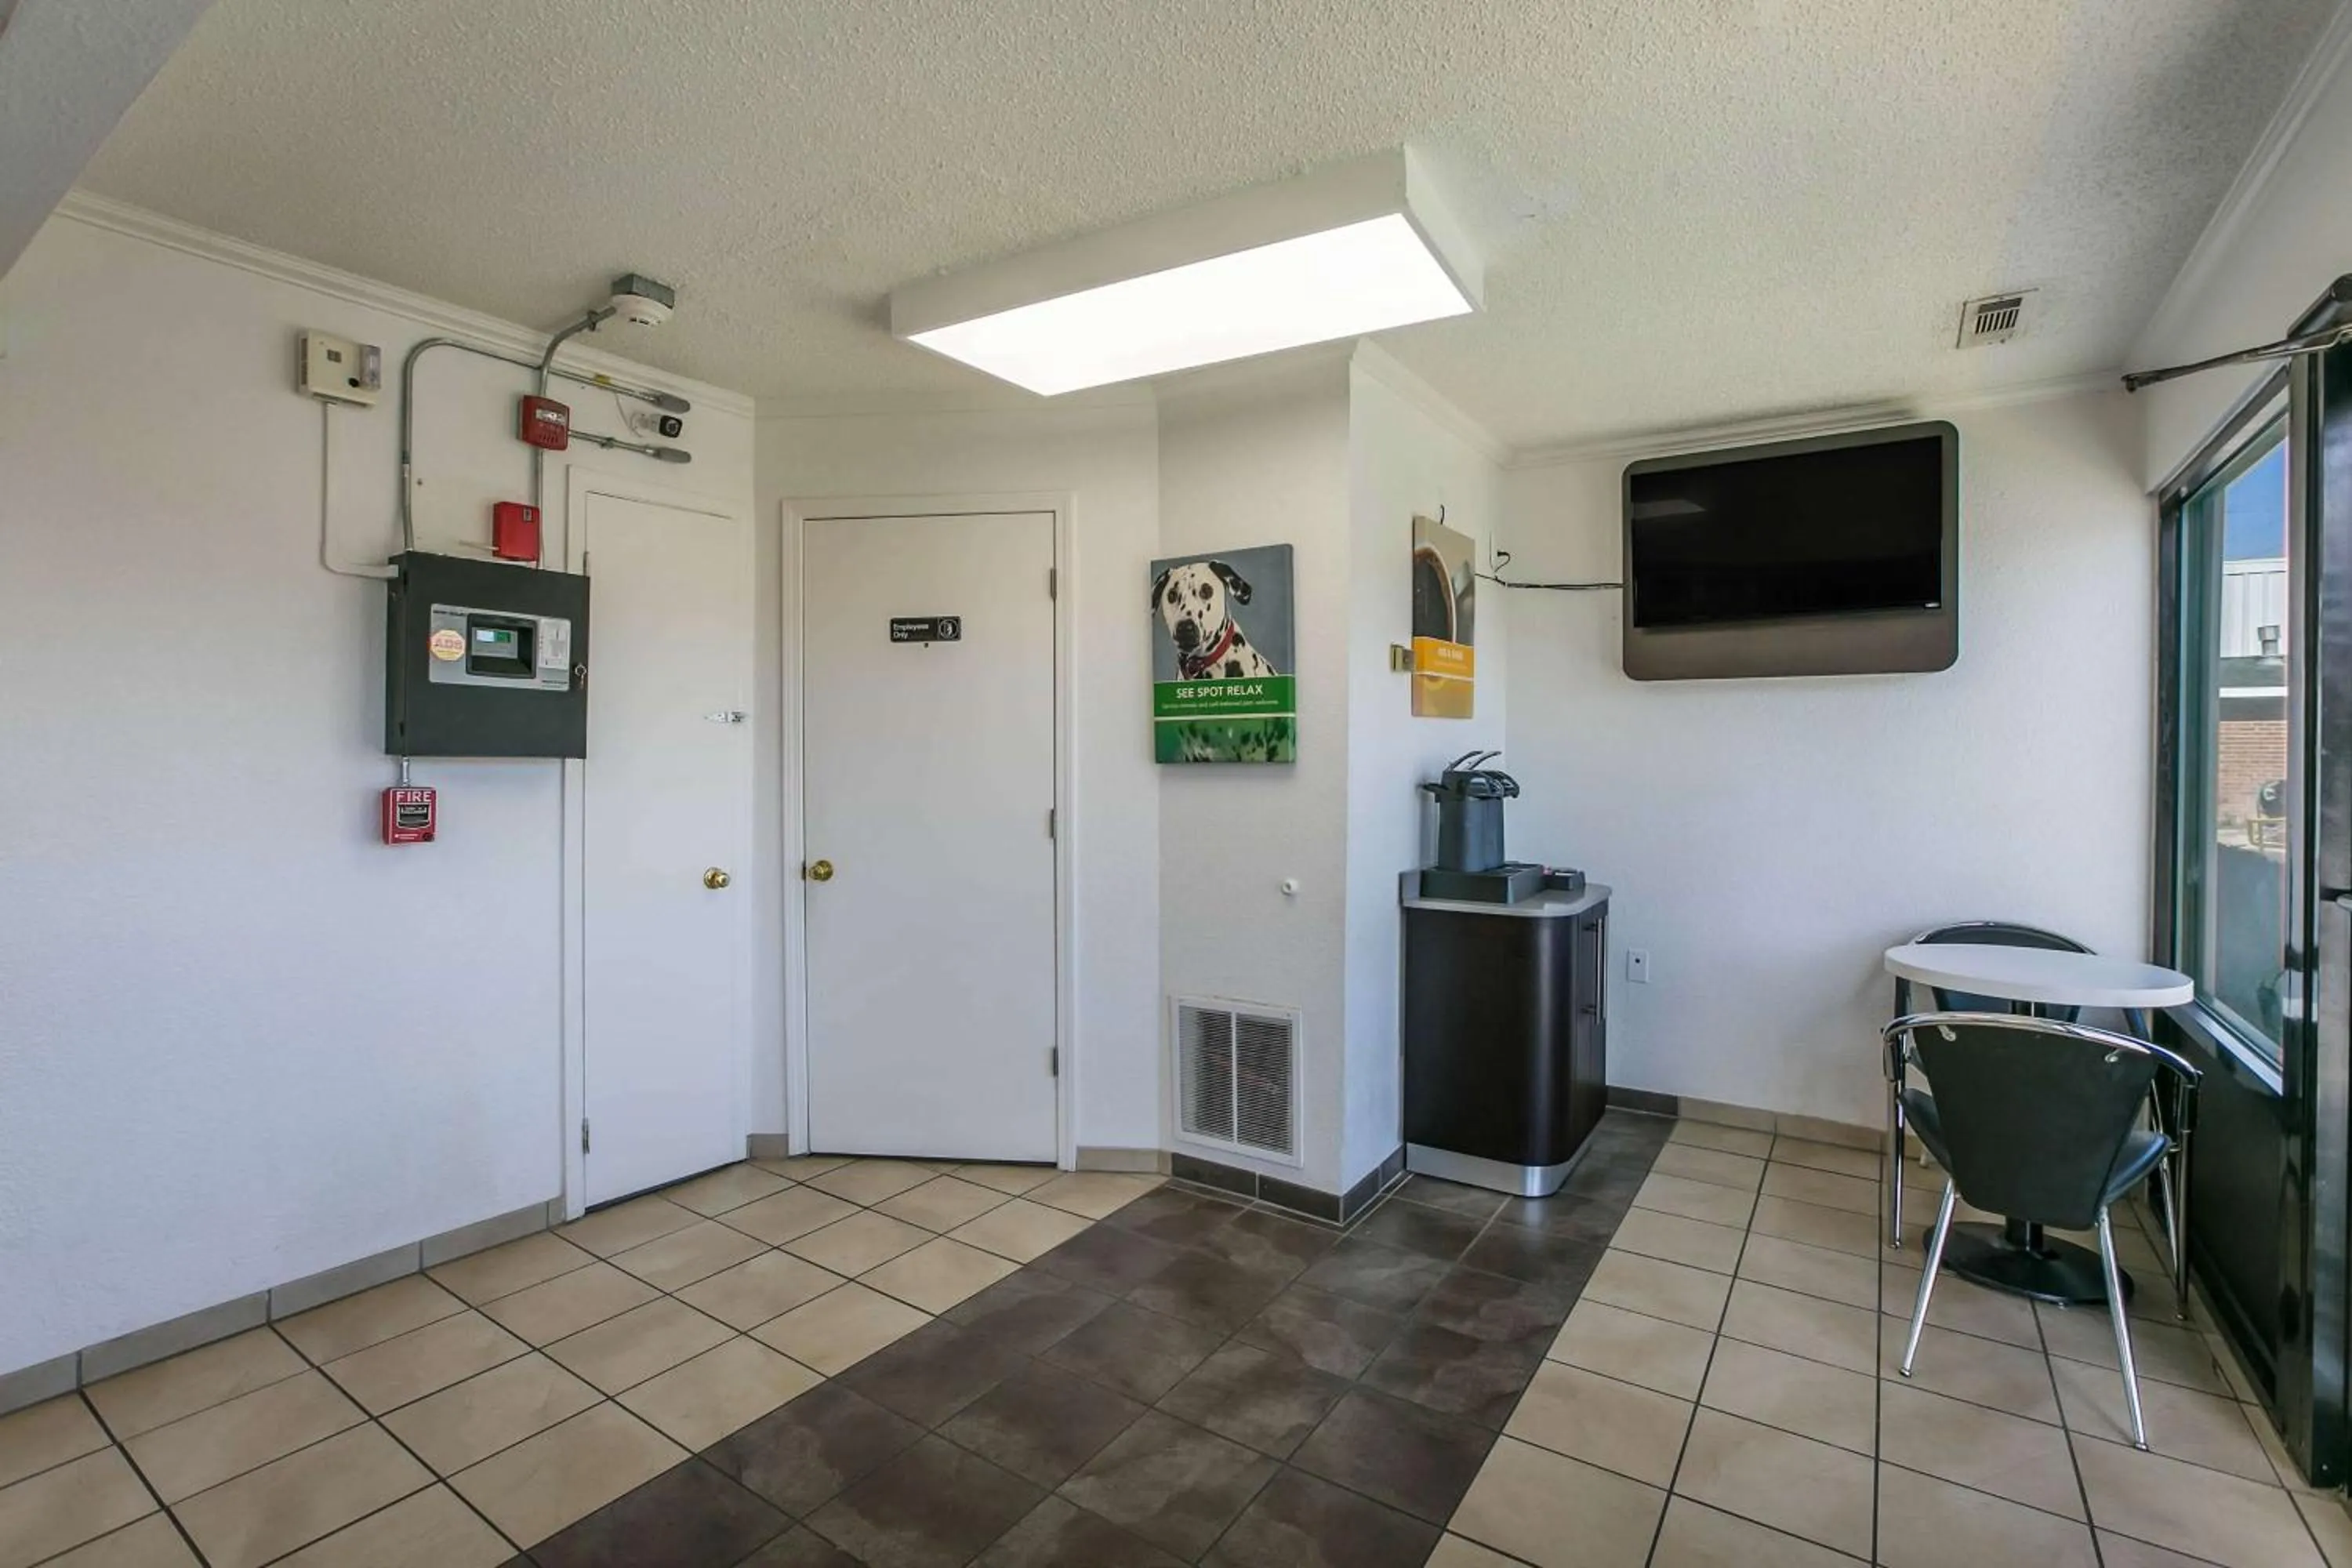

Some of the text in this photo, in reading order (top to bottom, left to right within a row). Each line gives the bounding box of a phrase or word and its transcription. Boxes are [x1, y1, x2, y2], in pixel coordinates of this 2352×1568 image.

[894, 631, 909, 640] Only
[1176, 684, 1263, 699] SEE SPOT RELAX
[396, 791, 432, 802] FIRE
